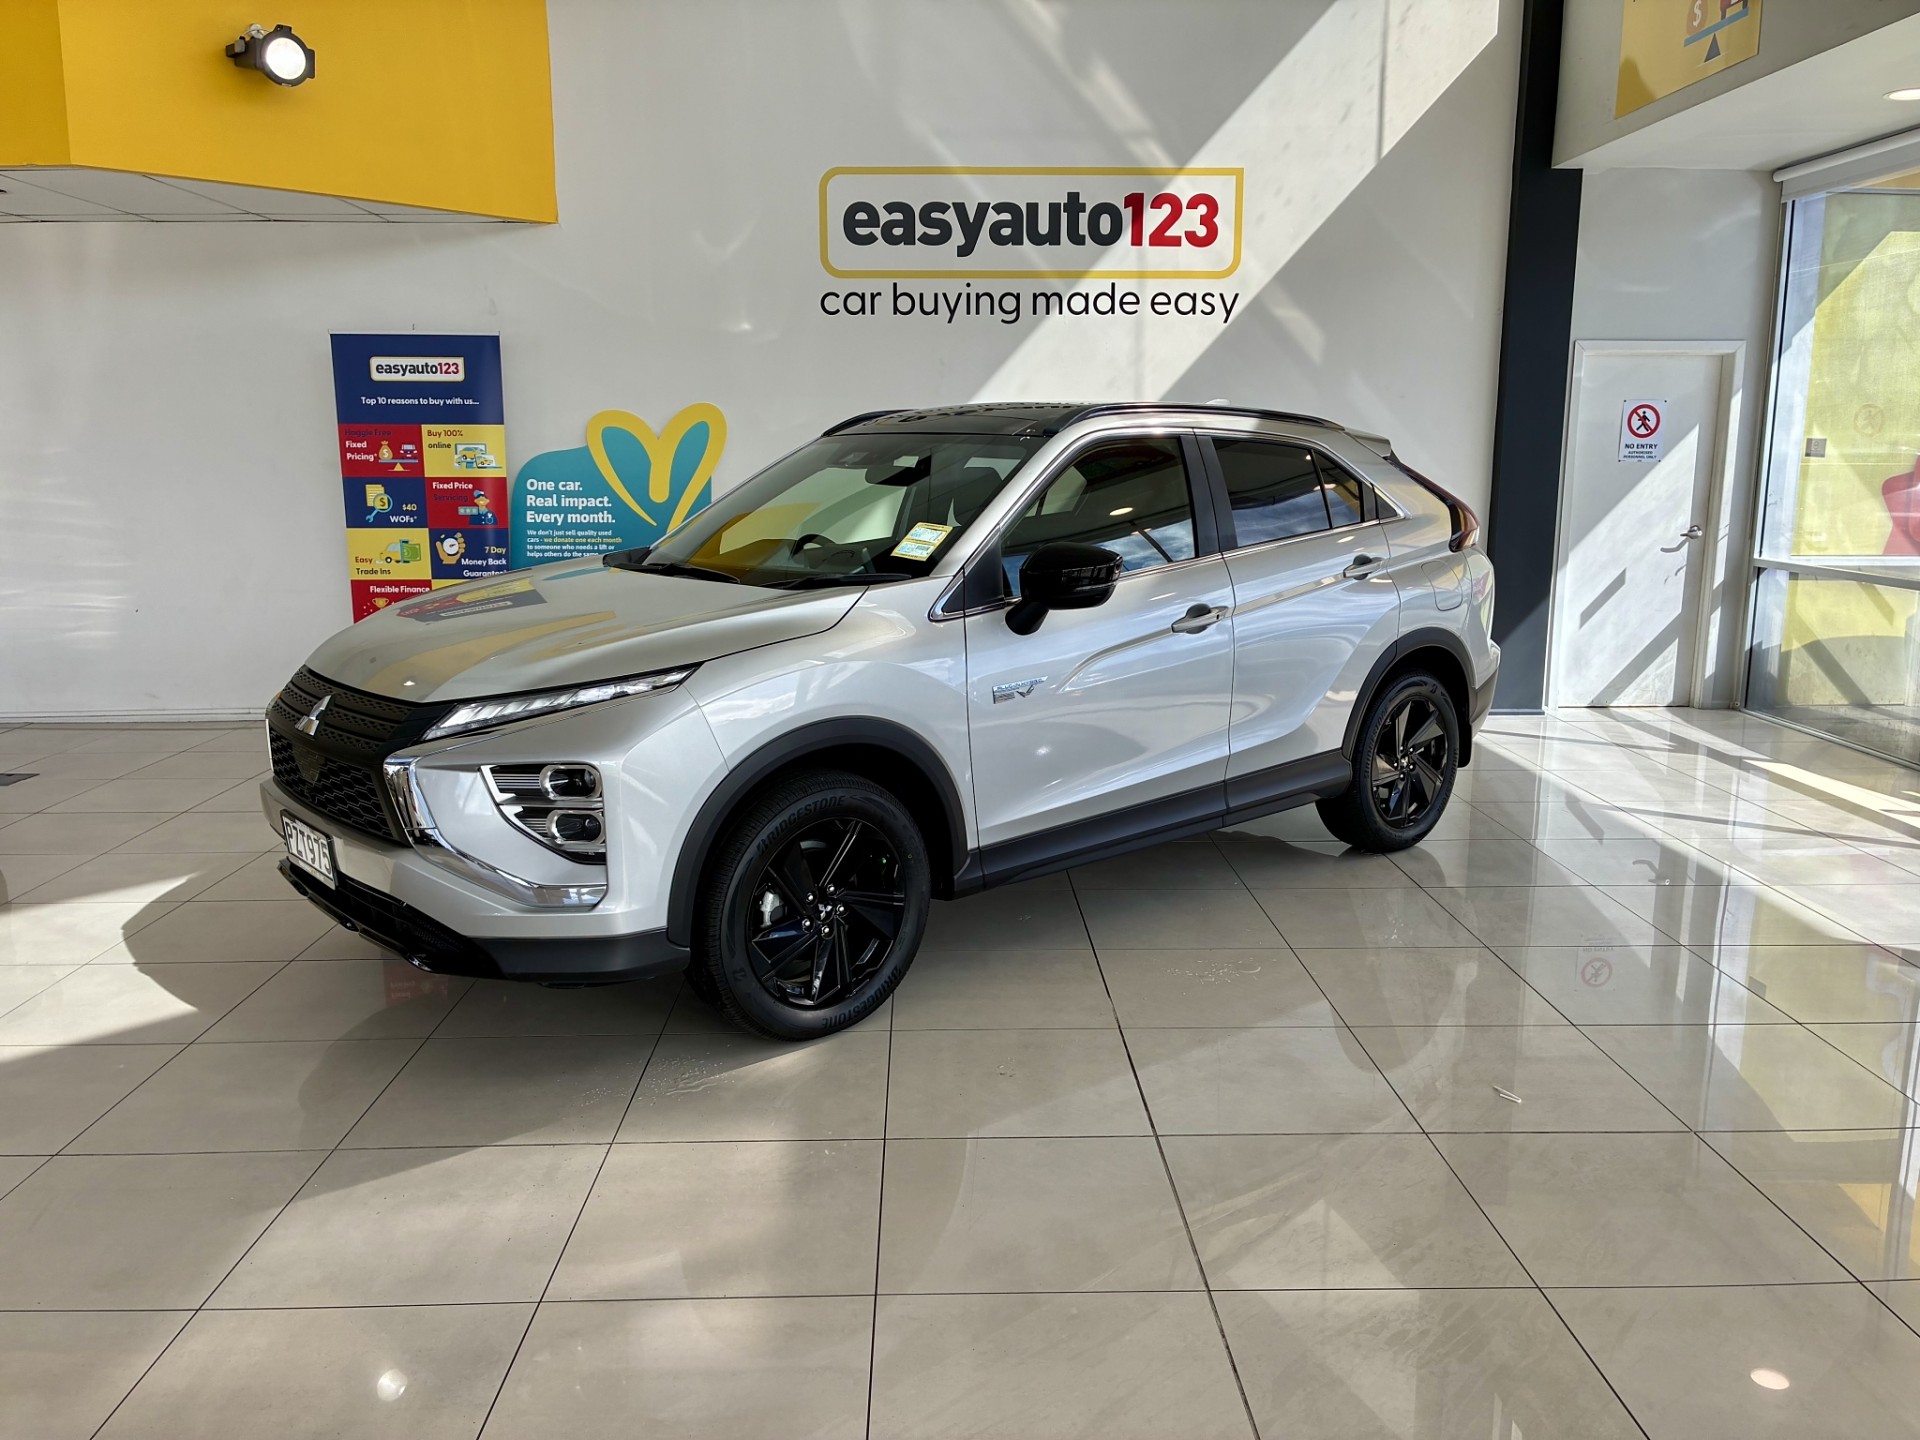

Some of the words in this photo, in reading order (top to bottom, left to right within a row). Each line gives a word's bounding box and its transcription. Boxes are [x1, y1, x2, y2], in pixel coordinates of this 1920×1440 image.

[843, 191, 1220, 258] easyauto123
[820, 290, 883, 317] car
[892, 282, 1021, 325] buying
[1031, 282, 1140, 317] made
[1150, 290, 1240, 324] easy
[376, 362, 460, 376] easyauto123
[361, 397, 376, 406] Top
[429, 397, 443, 406] buy
[446, 397, 463, 405] with
[344, 429, 372, 437] Haggle
[427, 430, 442, 438] Buy
[526, 479, 555, 490] One
[558, 481, 582, 490] car.
[434, 494, 468, 502] Servicing
[526, 494, 558, 506] Real
[561, 495, 612, 510] impact.
[526, 511, 564, 526] Every
[567, 511, 615, 522] month.
[355, 557, 373, 565] Easy
[284, 821, 332, 875] PZT975
